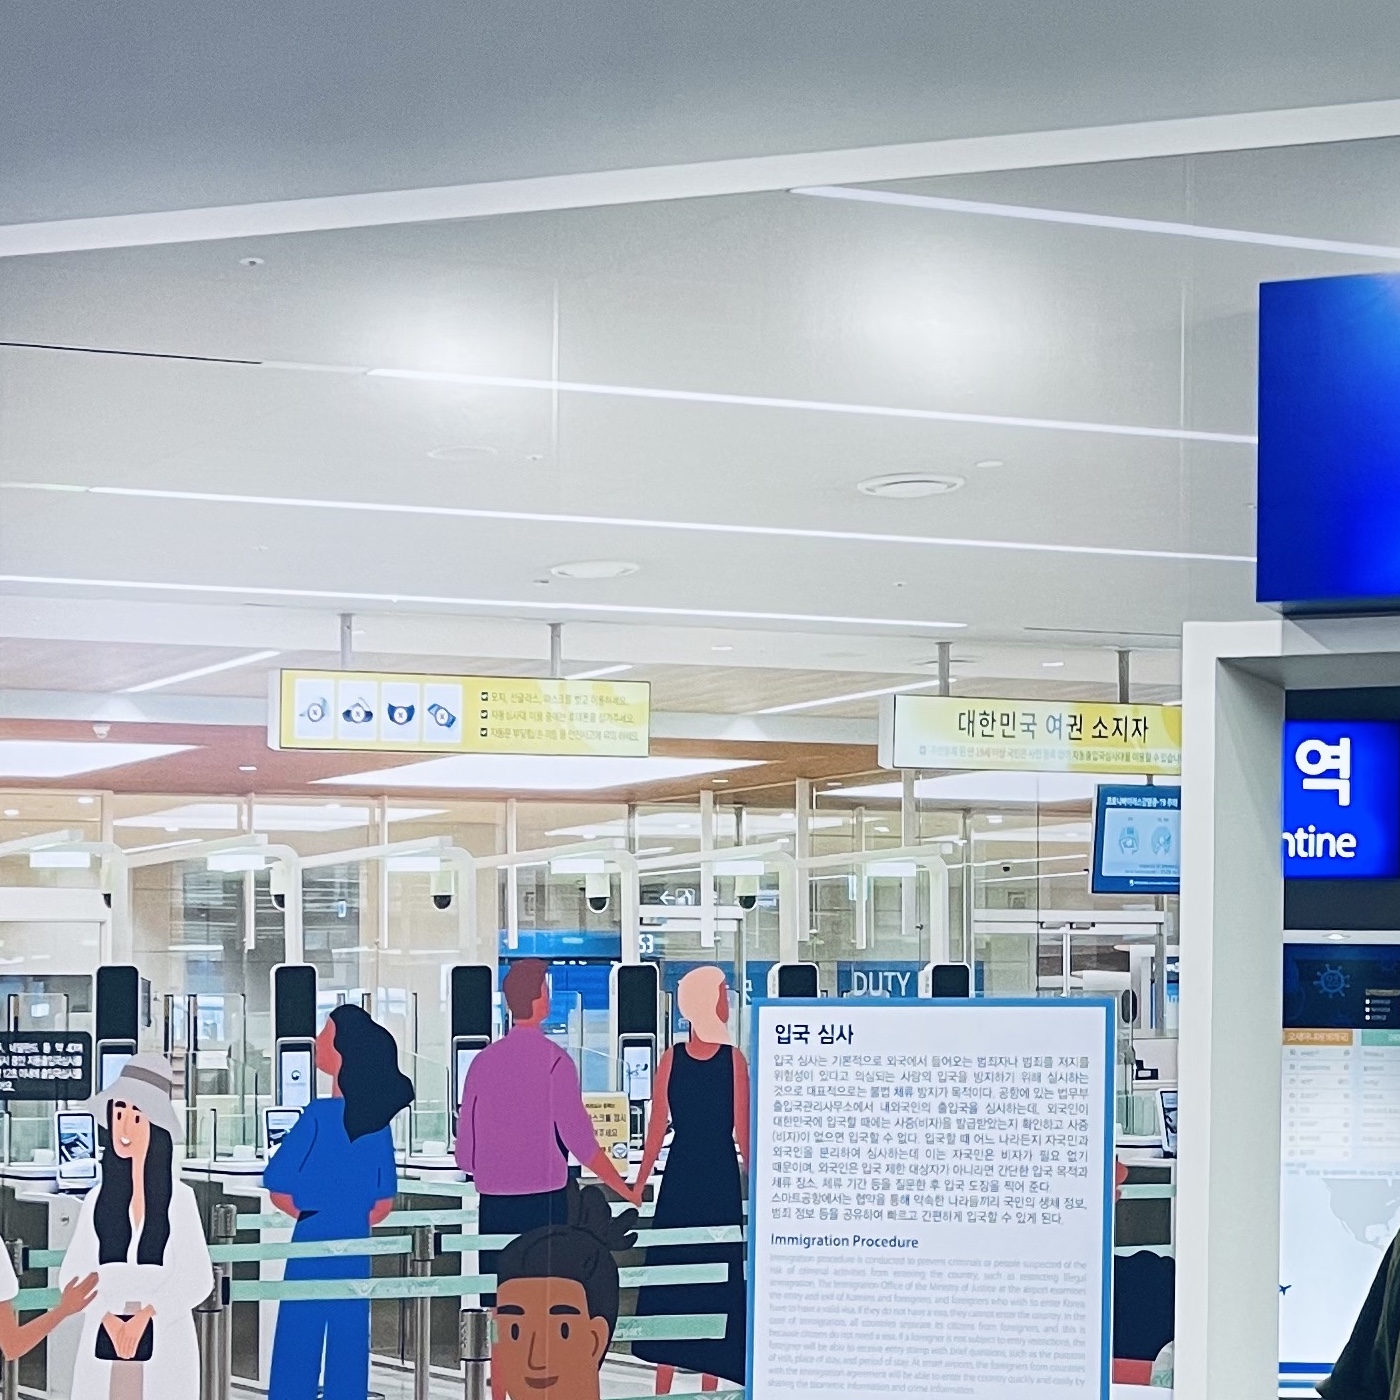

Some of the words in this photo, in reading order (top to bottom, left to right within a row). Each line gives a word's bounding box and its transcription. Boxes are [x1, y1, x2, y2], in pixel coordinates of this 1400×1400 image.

[958, 709, 1037, 740] 대한민국
[1046, 713, 1083, 741] 여권
[1091, 715, 1149, 744] 소지자
[1296, 737, 1351, 806] 역
[853, 970, 912, 997] DUTY
[775, 1023, 811, 1045] 입국
[817, 1023, 854, 1045] 심사
[774, 1055, 793, 1067] 입국
[798, 1055, 827, 1067] 심사는
[833, 1055, 881, 1067] 기본적으로
[887, 1055, 927, 1067] 외국에서
[977, 1056, 1017, 1068] 범죄자나
[819, 1070, 848, 1082] 있다고
[856, 1071, 894, 1083] 의심되는
[901, 1070, 931, 1083] 사람의
[938, 1070, 967, 1084] 입국을
[1022, 1071, 1041, 1083] 위해
[775, 1086, 802, 1097] 것으로
[807, 1086, 865, 1097] 대표적으로는
[918, 1087, 948, 1099] 방지가
[1000, 1086, 1029, 1100] 공항에
[1034, 1088, 1054, 1100] 있는
[1058, 1088, 1087, 1100] 법무부
[774, 1100, 873, 1113] 출입국관리사무소에서
[881, 1101, 930, 1113] 내외국인의
[938, 1101, 977, 1115] 출입국을
[1048, 1102, 1088, 1116] 외국인이
[827, 1115, 856, 1129] 입국할
[1068, 1118, 1088, 1132] 사증
[814, 1132, 844, 1144] 없으면
[849, 1131, 879, 1144] 입국할
[884, 1132, 893, 1143] 수
[925, 1133, 955, 1145] 입국할
[960, 1133, 969, 1145] 때
[974, 1133, 995, 1145] 어느
[999, 1134, 1041, 1146] 나라든지
[1046, 1134, 1088, 1146] 자국민과
[774, 1146, 812, 1159] 외국인을
[868, 1147, 918, 1160] 심사하는데
[926, 1149, 945, 1161] 이는
[953, 1148, 993, 1161] 자국민은
[1002, 1150, 1032, 1161] 비자가
[1067, 1150, 1087, 1163] 없기
[819, 1161, 858, 1175] 외국인은
[862, 1162, 881, 1175] 입국
[909, 1164, 949, 1176] 대상자가
[953, 1164, 993, 1177] 아니라면
[999, 1164, 1028, 1177] 간단한
[1033, 1165, 1053, 1178] 입국
[1058, 1166, 1087, 1178] 목적과
[848, 1178, 866, 1191] 기간
[872, 1178, 890, 1191] 등을
[930, 1179, 939, 1191] 후
[945, 1180, 964, 1192] 입국
[970, 1179, 998, 1193] 도장을
[772, 1192, 851, 1206] 스마트공항에서는
[914, 1194, 944, 1207] 약속한
[949, 1195, 999, 1208] 나라들끼리
[1004, 1195, 1034, 1209] 국민의
[772, 1208, 790, 1219] 범죄
[796, 1208, 814, 1219] 정보
[820, 1207, 838, 1221] 등을
[844, 1208, 882, 1221] 공유하여
[922, 1210, 962, 1223] 간편하게
[967, 1211, 997, 1223] 입국할
[1002, 1212, 1011, 1224] 수
[1016, 1212, 1036, 1224] 있게
[771, 1233, 850, 1250] Immigration
[852, 1234, 919, 1249] Procedure
